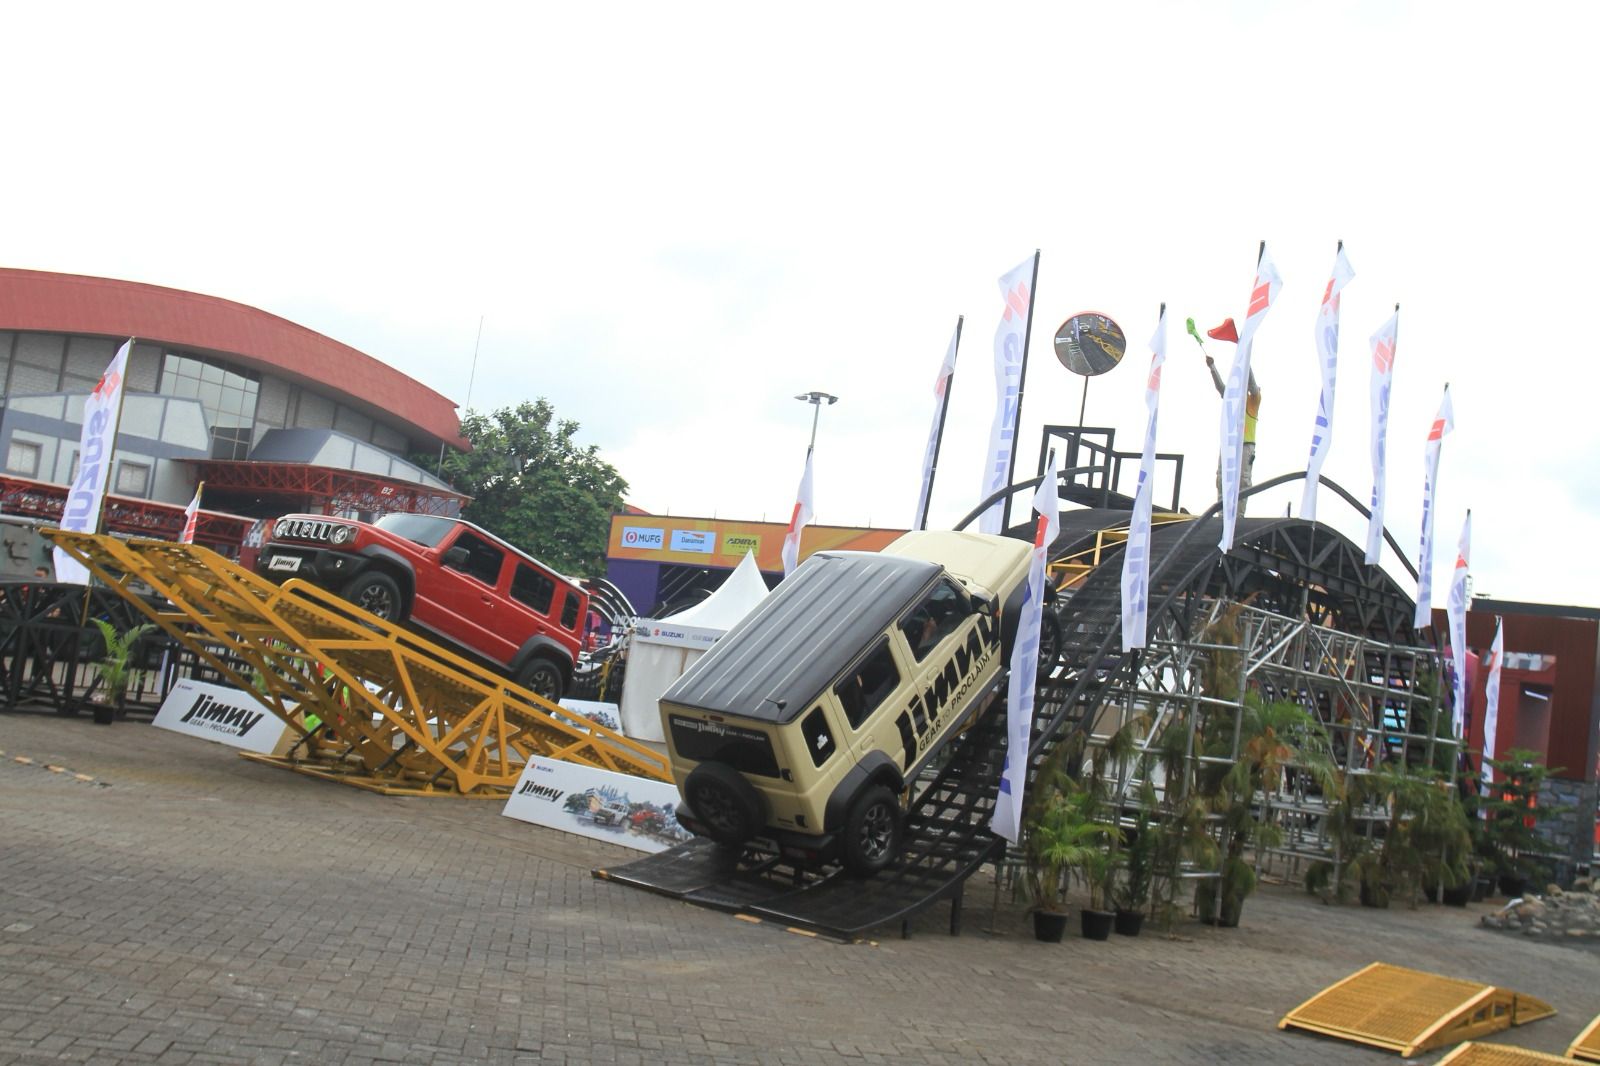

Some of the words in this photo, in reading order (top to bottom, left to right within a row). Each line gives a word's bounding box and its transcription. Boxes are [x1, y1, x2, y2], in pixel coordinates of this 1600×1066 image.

[380, 486, 395, 496] B2
[637, 533, 661, 544] MUFG
[661, 630, 685, 640] SUZUKI
[918, 719, 942, 752] GEAR
[950, 652, 990, 711] PROCLAIM
[179, 692, 265, 738] Jimny
[517, 779, 565, 803] Jimny
